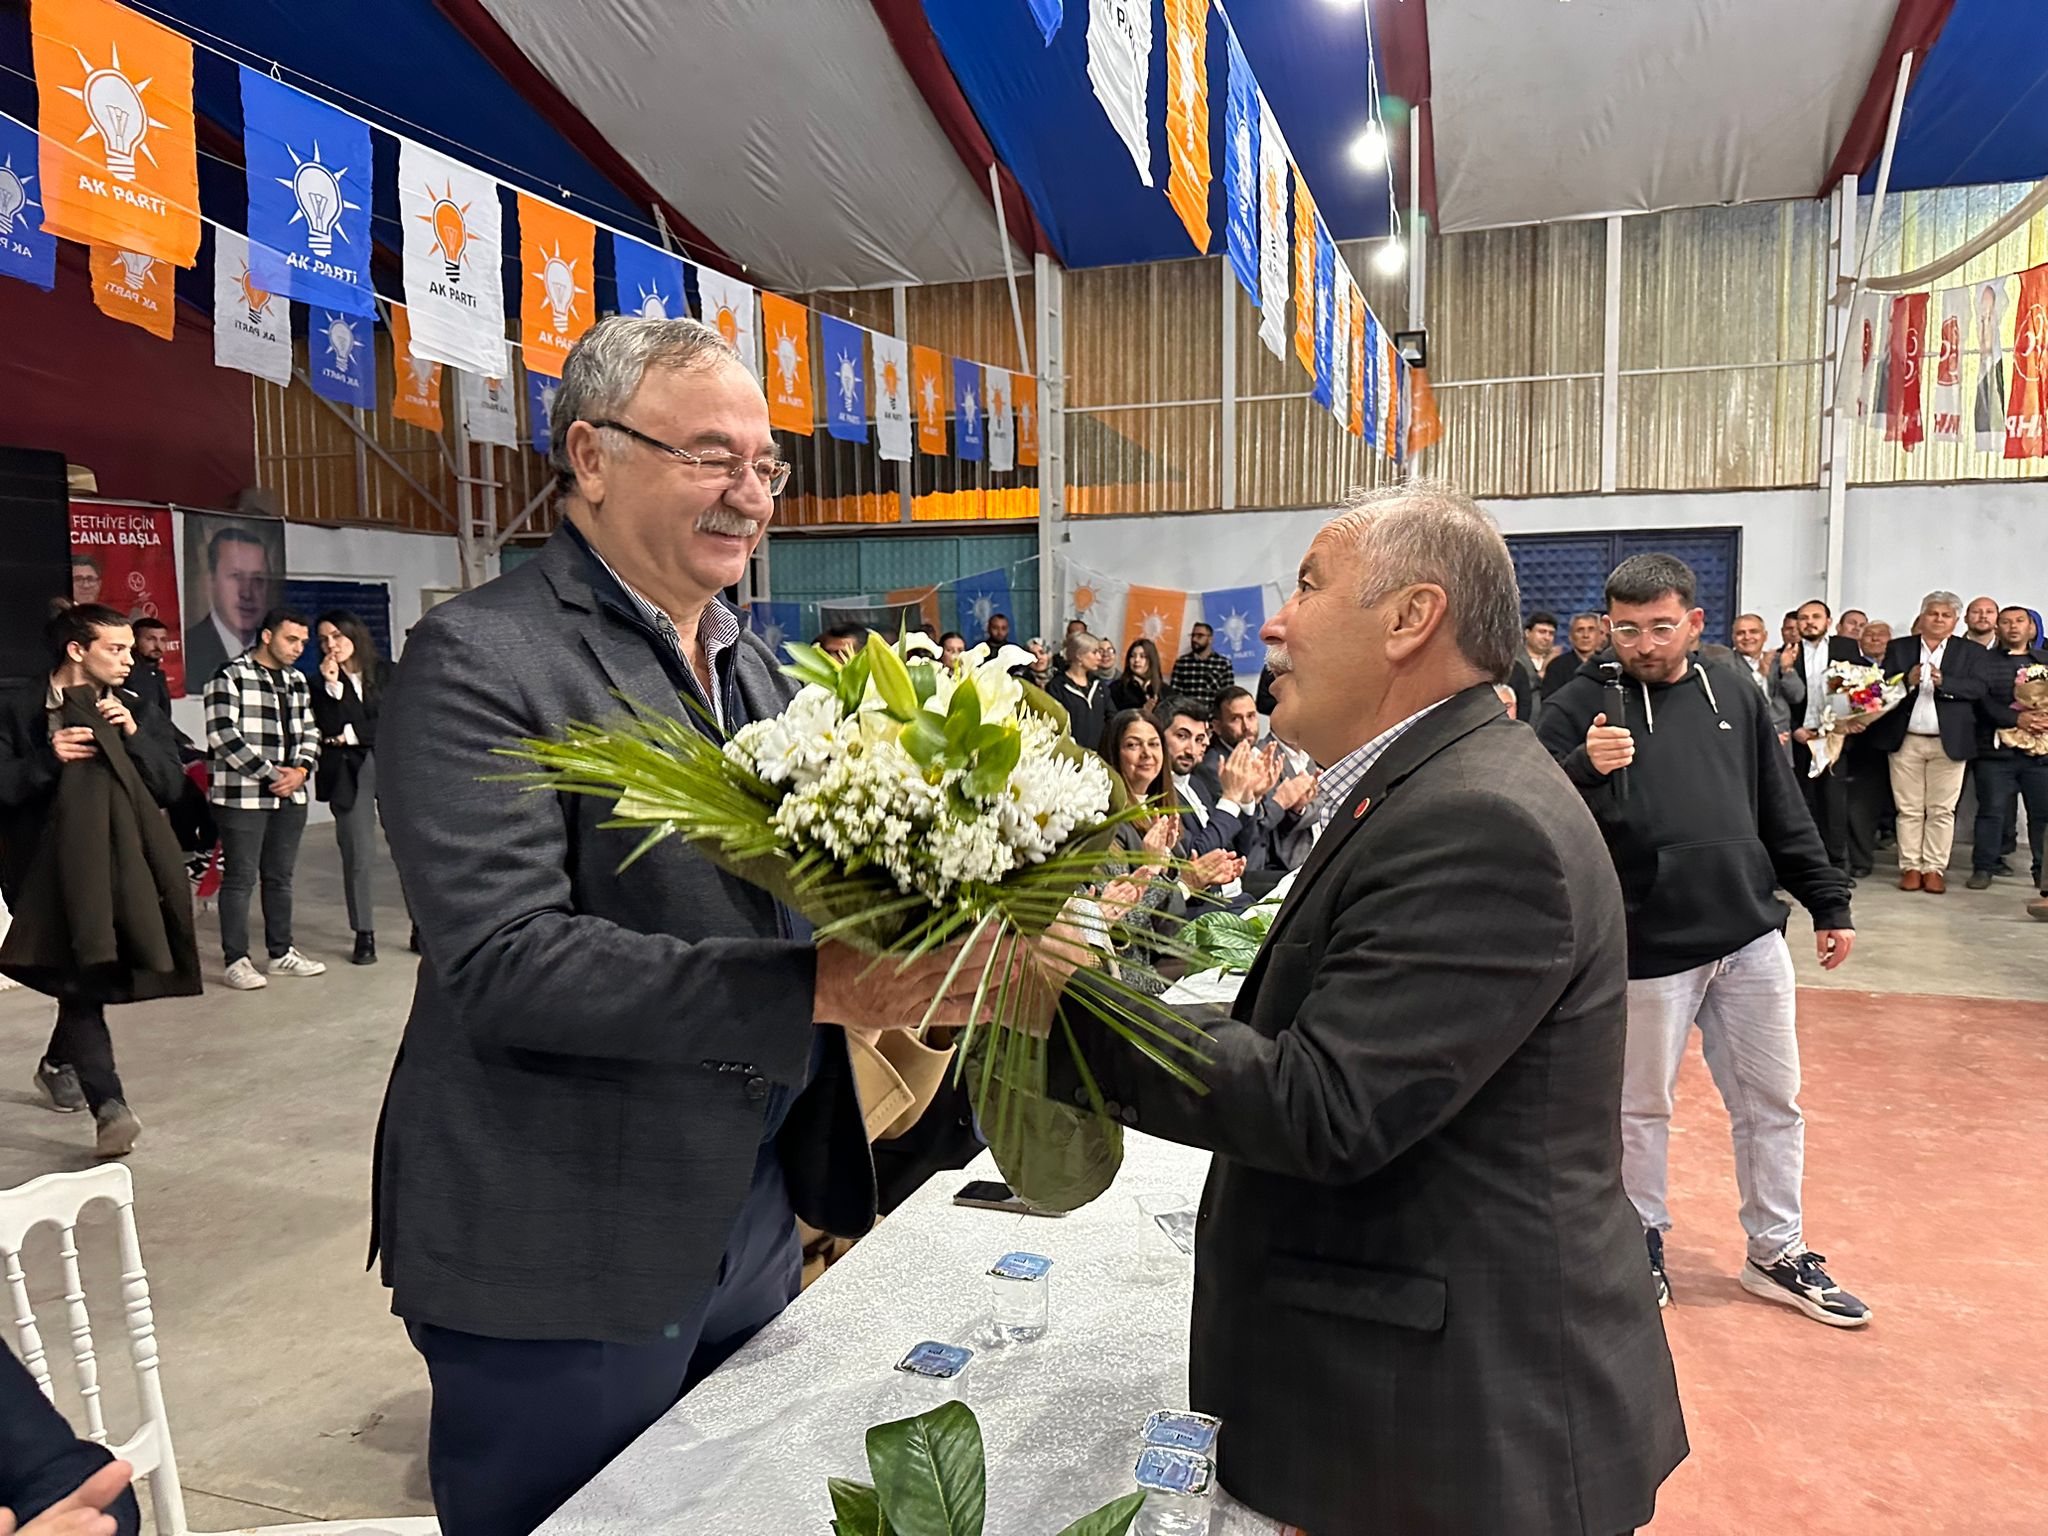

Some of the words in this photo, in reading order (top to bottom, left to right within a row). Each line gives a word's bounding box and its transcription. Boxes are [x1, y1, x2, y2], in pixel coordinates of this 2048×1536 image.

[78, 174, 107, 198] AK
[286, 252, 310, 271] AK
[429, 281, 447, 299] AK
[539, 330, 553, 346] AK
[555, 335, 577, 351] PAR
[72, 514, 126, 530] FETHİYE
[129, 515, 155, 533] İÇİN
[70, 531, 116, 545] CANLA
[119, 533, 161, 548] BAŞLA
